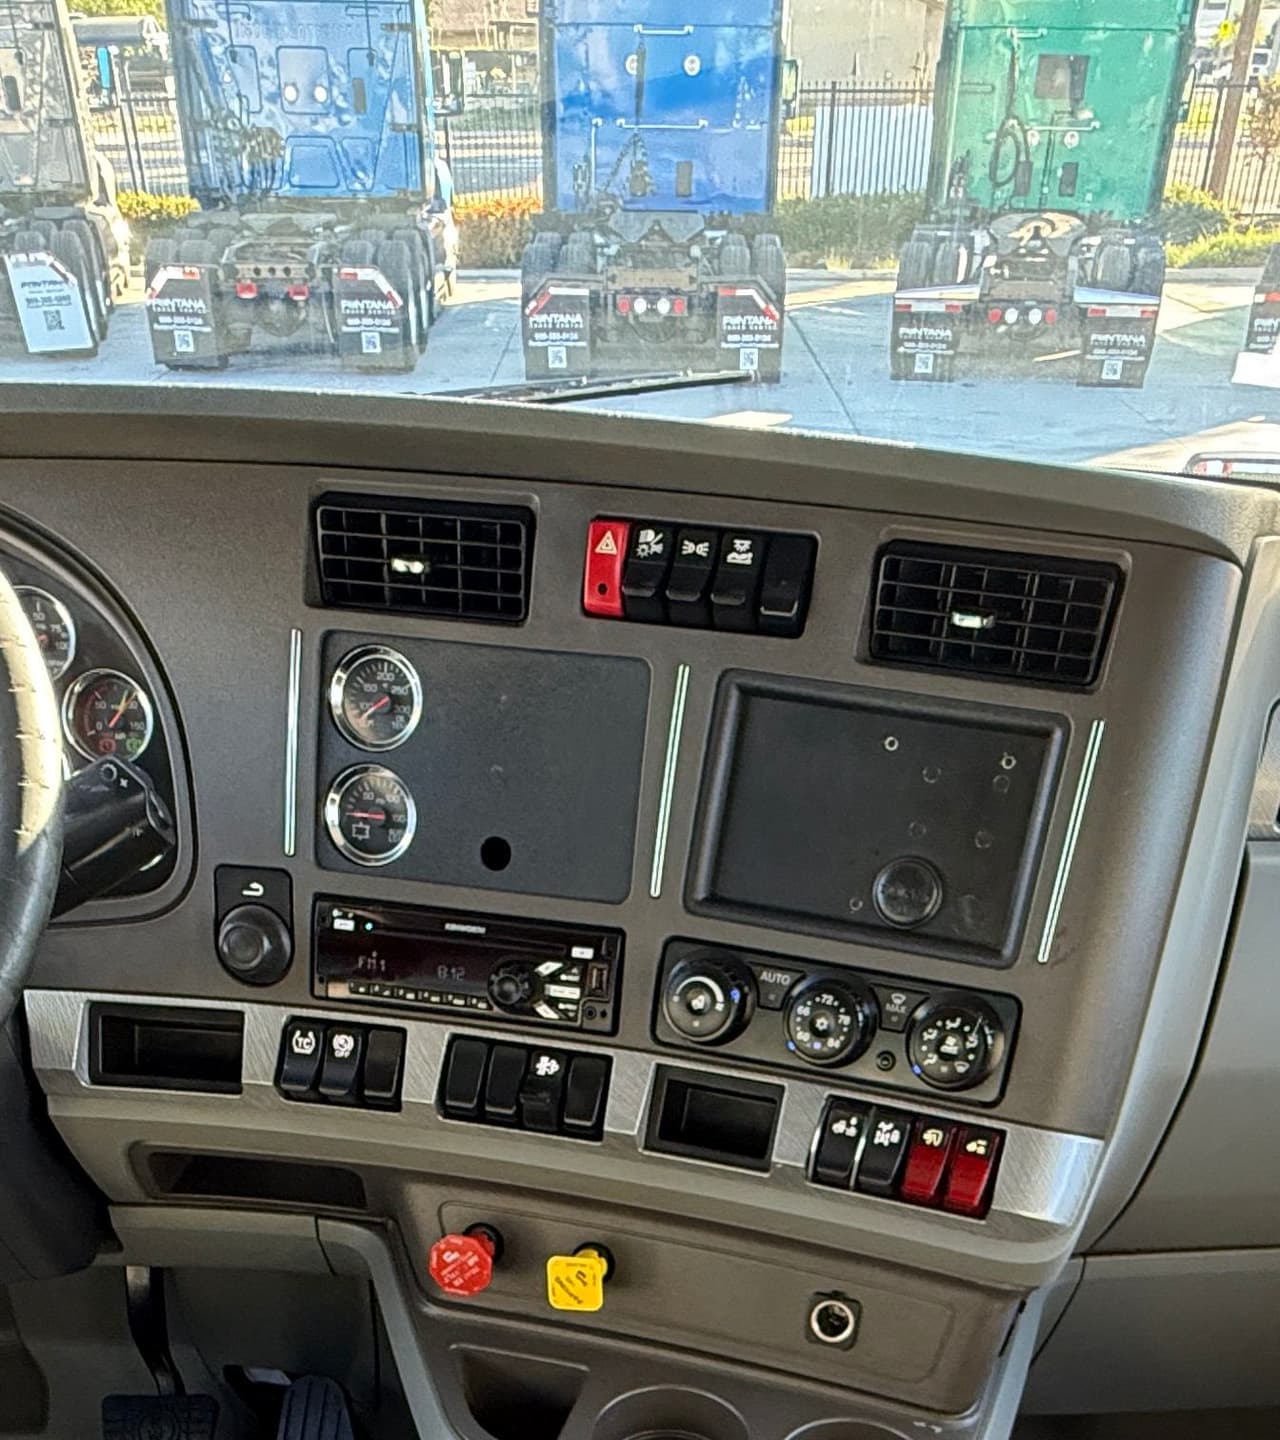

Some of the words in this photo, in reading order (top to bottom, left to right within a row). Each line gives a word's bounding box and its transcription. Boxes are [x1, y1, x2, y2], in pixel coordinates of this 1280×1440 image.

[376, 672, 395, 681] 200
[759, 971, 791, 987] AUTO
[821, 994, 834, 1005] 72
[796, 1005, 811, 1016] 66
[885, 1002, 907, 1014] MAX
[297, 1038, 311, 1048] TC
[826, 1037, 841, 1049] 84
[334, 1050, 351, 1059] OFF
